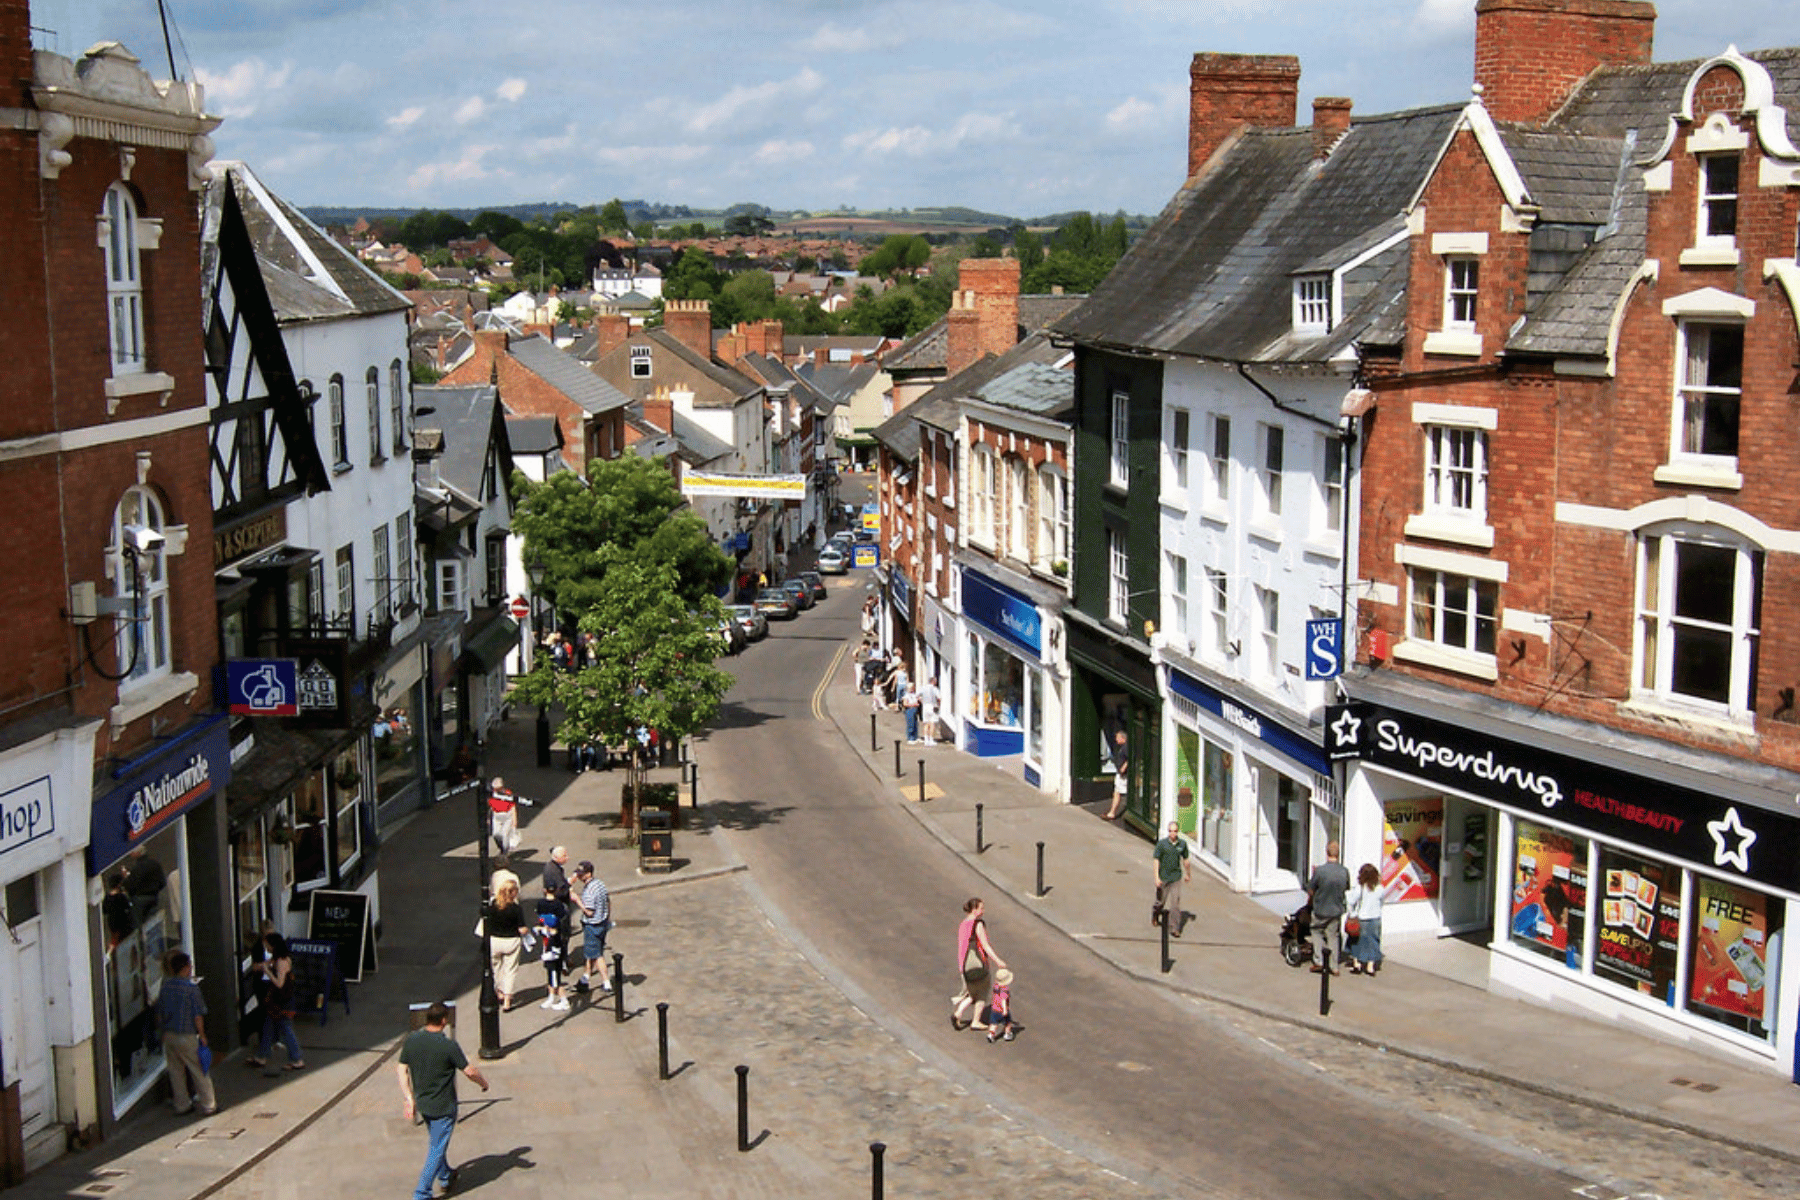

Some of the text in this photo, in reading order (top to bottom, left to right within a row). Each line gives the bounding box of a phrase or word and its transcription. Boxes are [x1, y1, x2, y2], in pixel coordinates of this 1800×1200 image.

[1311, 622, 1336, 636] WH
[1311, 635, 1337, 677] S
[1376, 718, 1563, 808] Superdrug
[142, 752, 210, 818] Nationwide
[1706, 895, 1755, 926] FREE
[1599, 927, 1628, 946] SAVE
